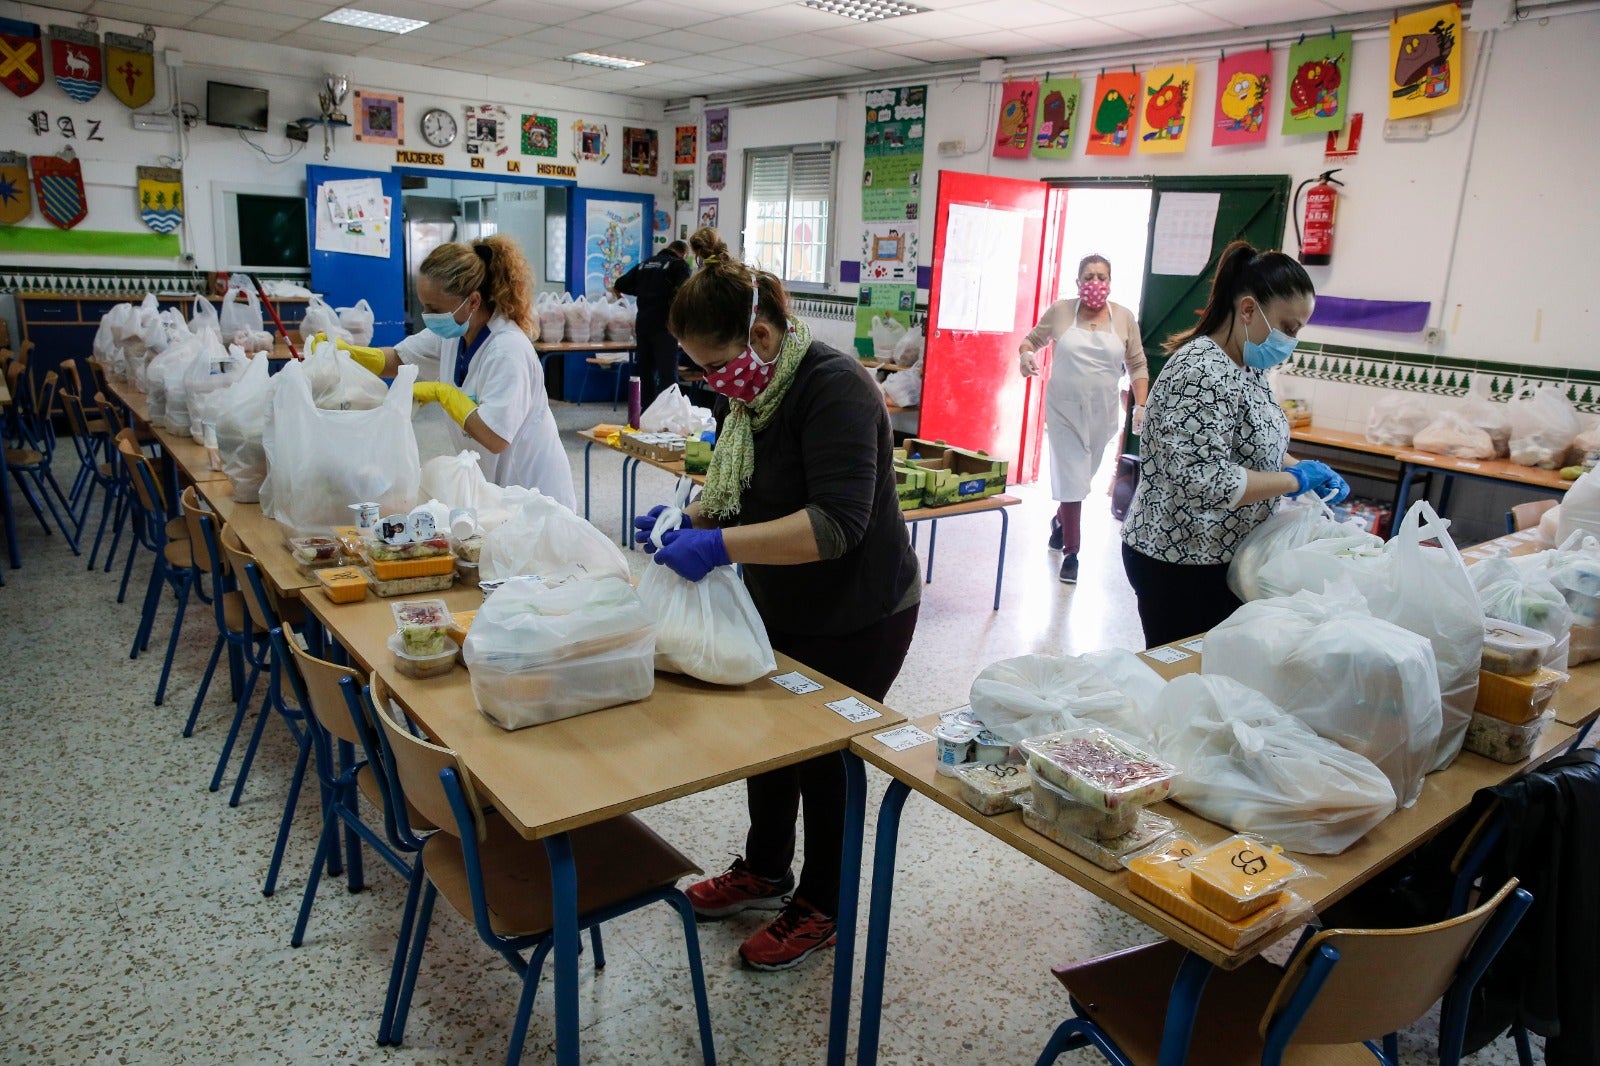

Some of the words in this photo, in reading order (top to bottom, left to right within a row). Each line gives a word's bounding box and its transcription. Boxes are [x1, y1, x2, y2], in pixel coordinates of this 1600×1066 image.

[396, 151, 445, 165] MUJERES
[471, 158, 484, 168] EN
[507, 161, 520, 172] LA
[537, 163, 576, 176] HISTORIA
[340, 401, 351, 411] 10
